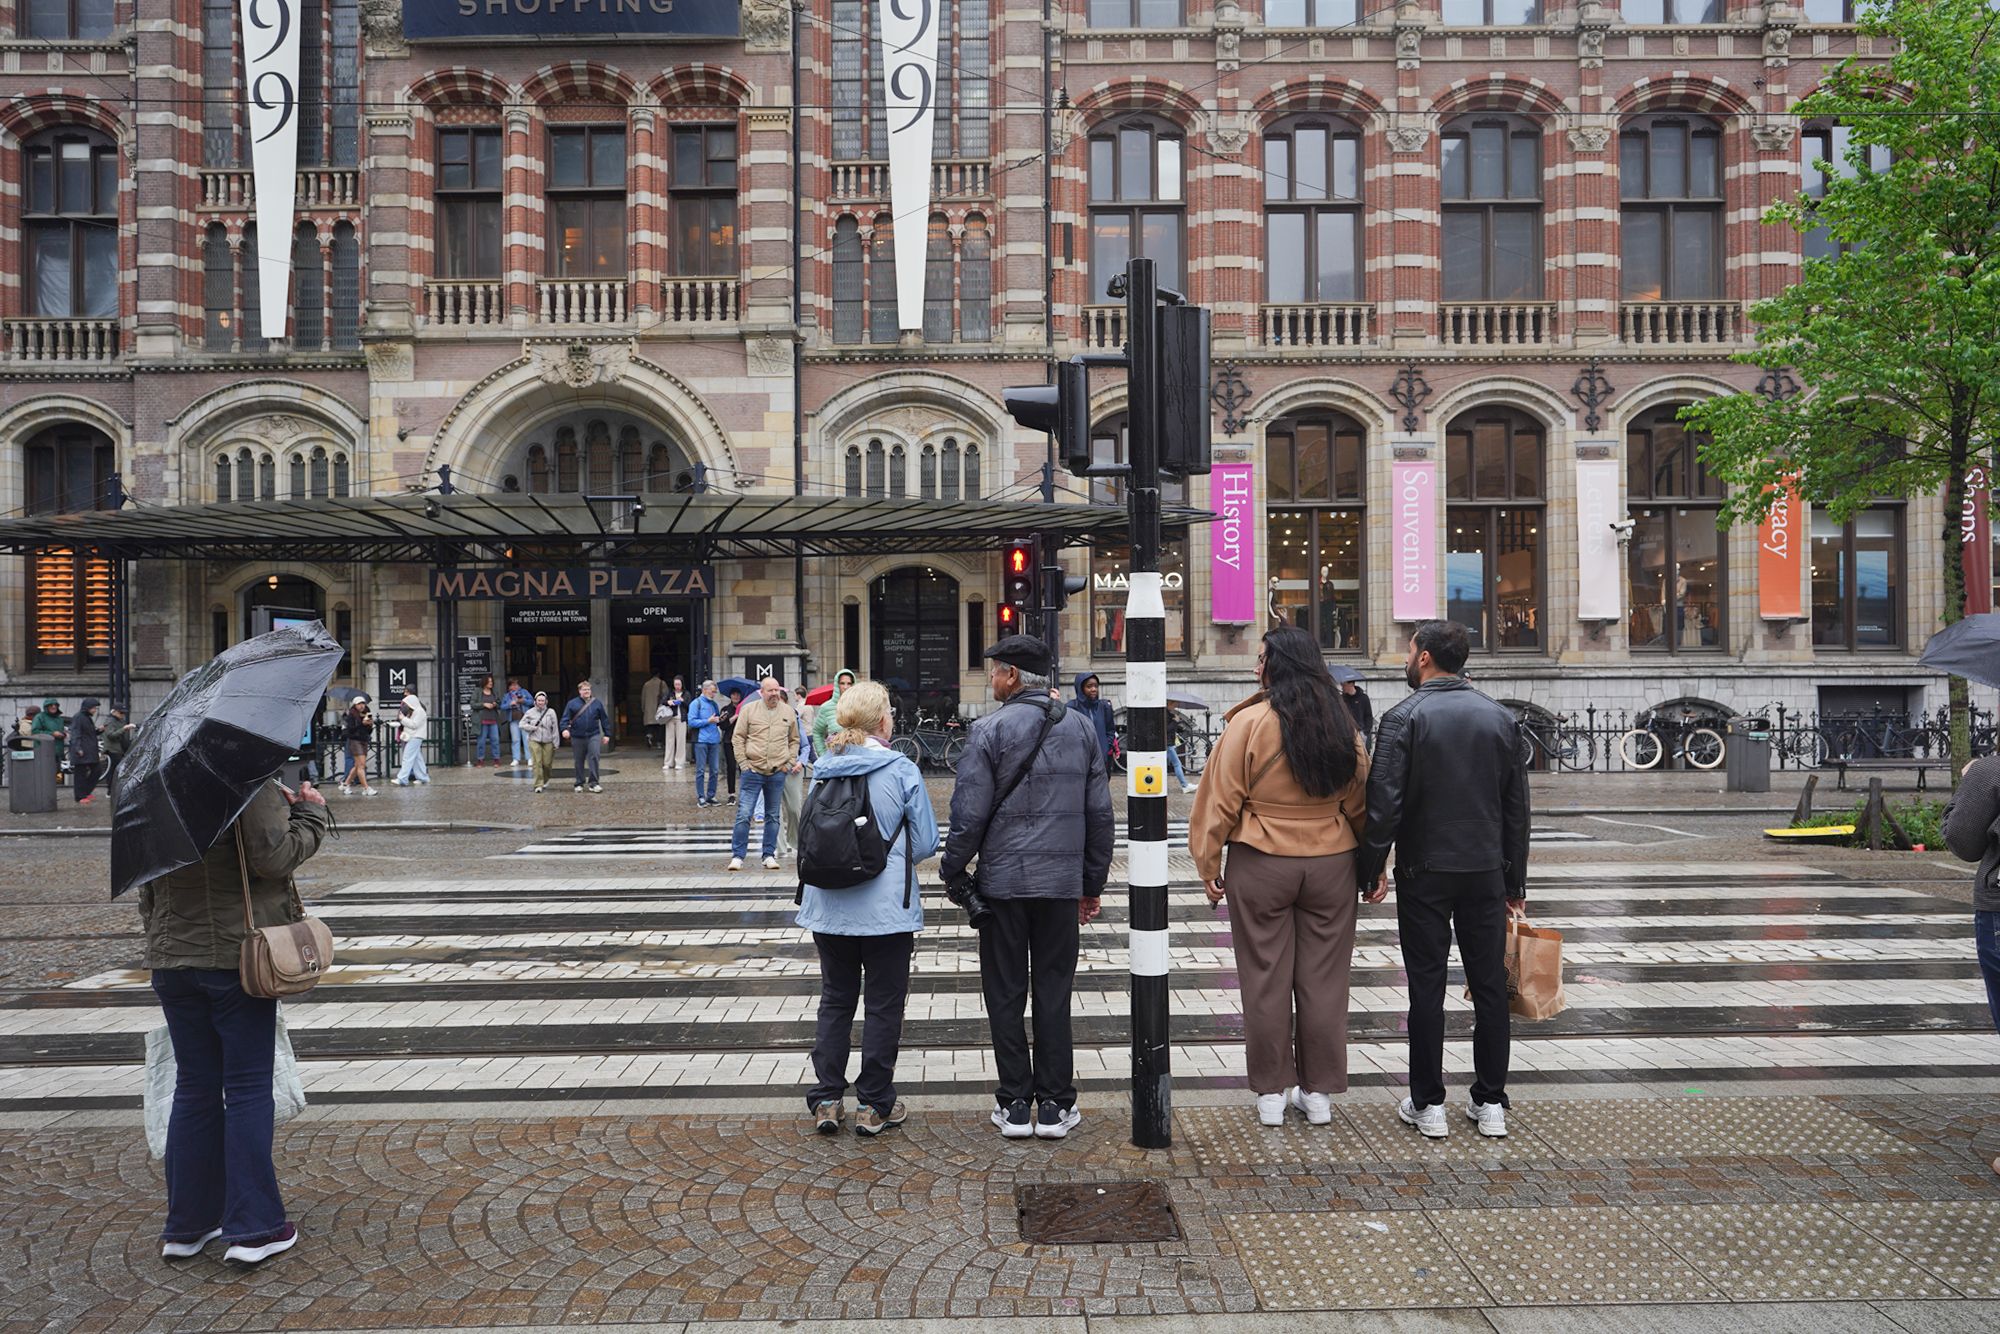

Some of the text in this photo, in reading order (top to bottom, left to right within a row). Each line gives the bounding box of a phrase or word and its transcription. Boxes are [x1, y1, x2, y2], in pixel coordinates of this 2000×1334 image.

[458, 0, 673, 16] SHOPPING
[1216, 471, 1248, 571] History
[1402, 469, 1428, 593] Souvenirs
[434, 569, 710, 598] MAGNA PLAZA
[1093, 572, 1183, 588] MAO
[643, 607, 667, 615] OPEN
